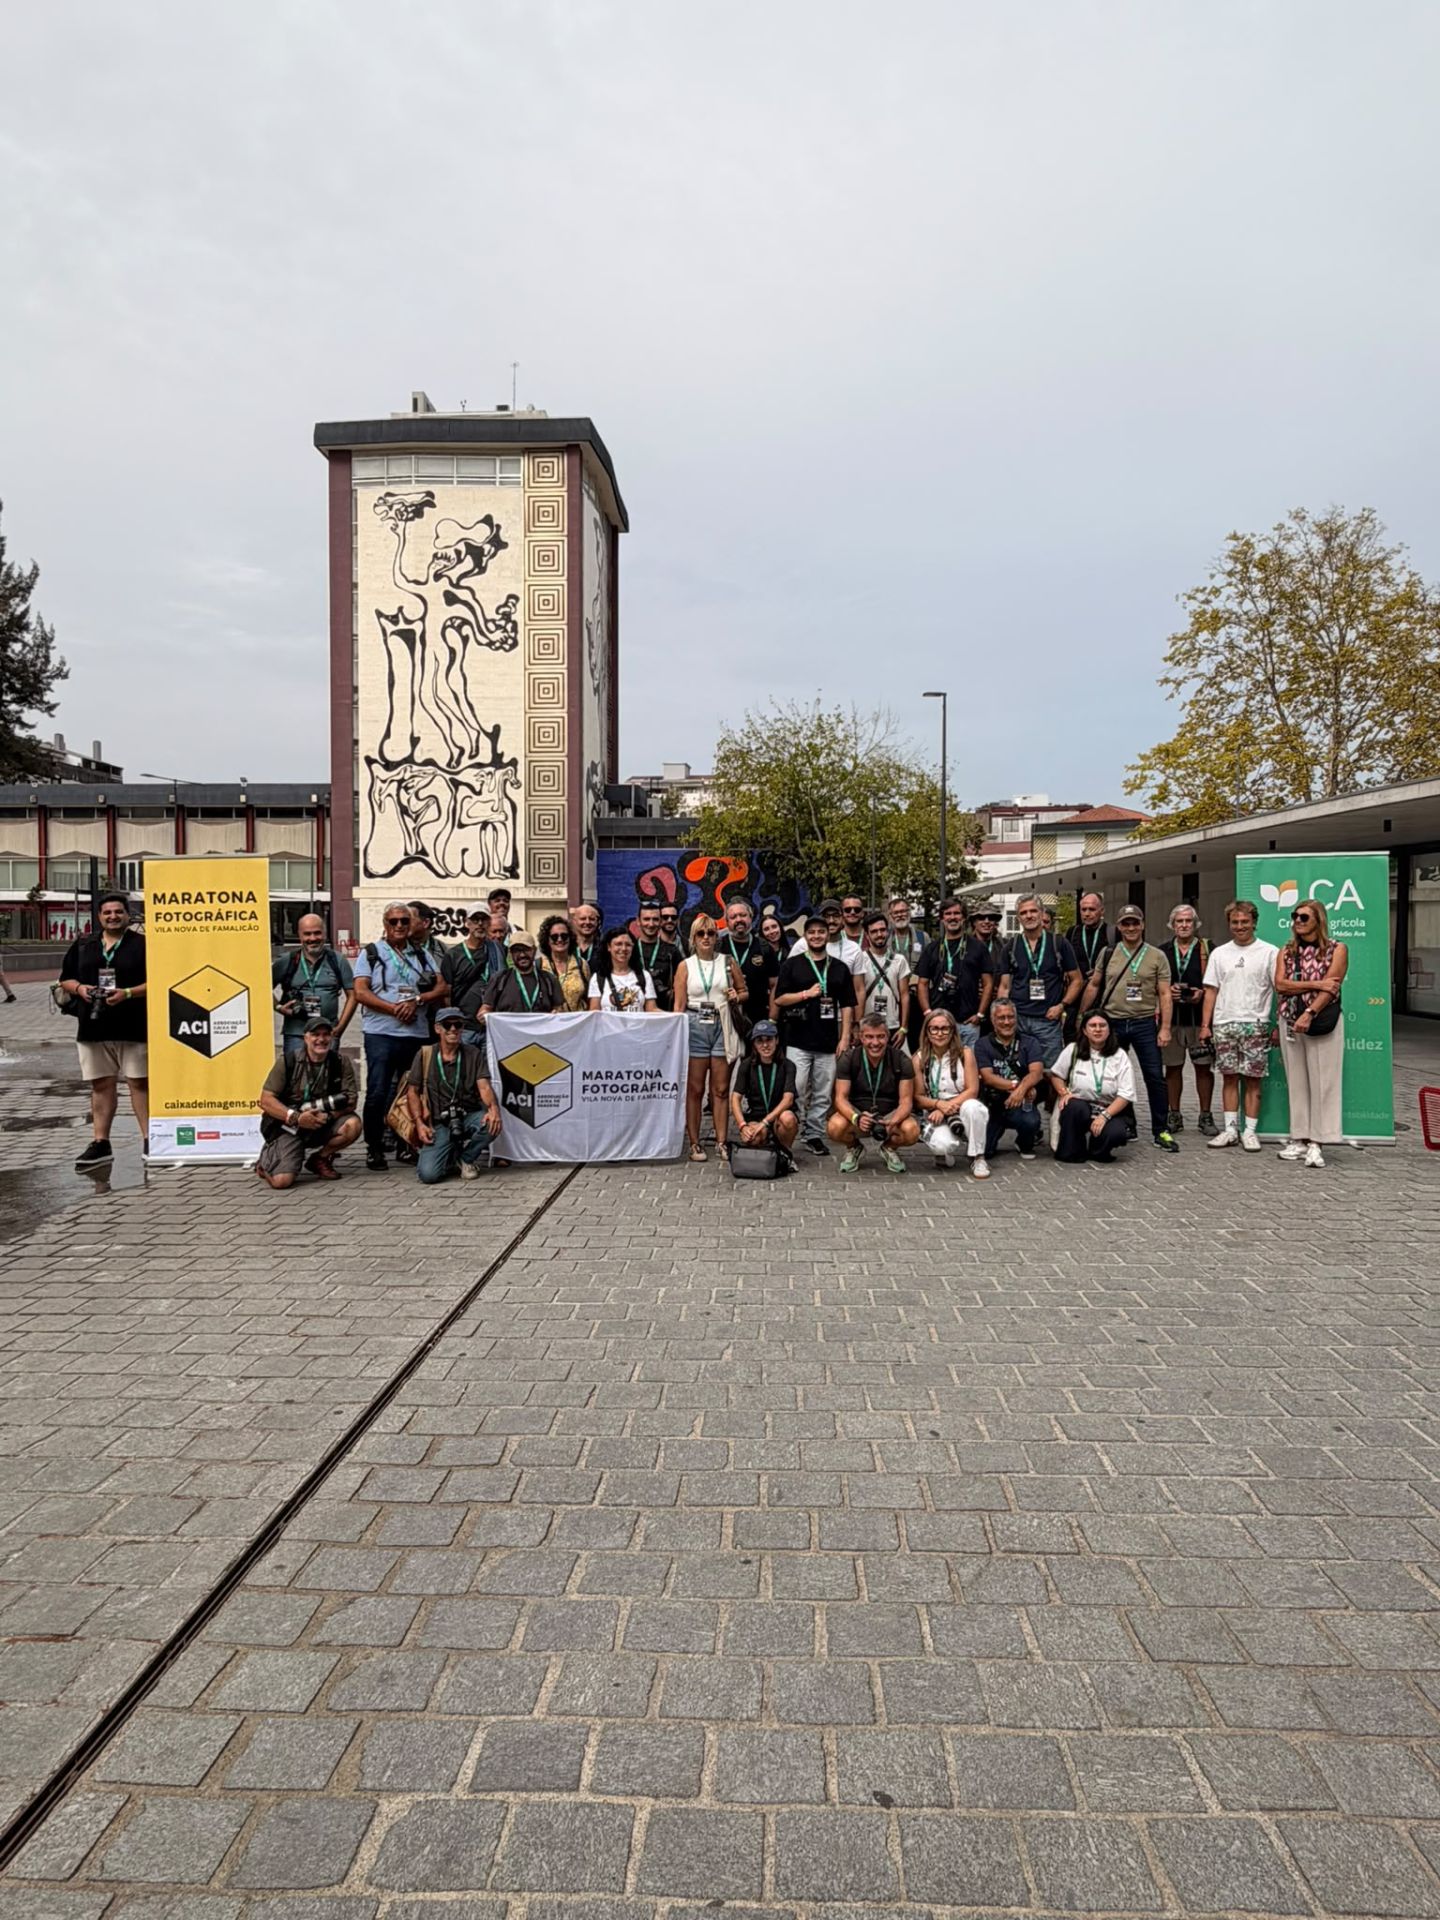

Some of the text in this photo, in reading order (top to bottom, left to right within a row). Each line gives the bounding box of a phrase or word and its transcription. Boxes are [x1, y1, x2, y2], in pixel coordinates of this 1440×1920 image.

[153, 891, 258, 905] MARATONA
[1309, 879, 1365, 910] CA
[155, 908, 259, 922] FOTOGRÁFICA
[174, 925, 198, 933] NOVA
[213, 923, 260, 932] FAMALICÃO
[1330, 918, 1366, 930] grícola
[178, 1021, 208, 1035] ACI
[1346, 1038, 1384, 1051] lidez
[582, 1069, 663, 1081] MARATONA
[582, 1081, 679, 1095] FOTOGRÁFICA
[506, 1091, 532, 1108] ACI
[601, 1095, 622, 1103] NOVA
[637, 1092, 679, 1101] FAMALICÃO
[164, 1099, 261, 1110] caixadeimagens.pt
